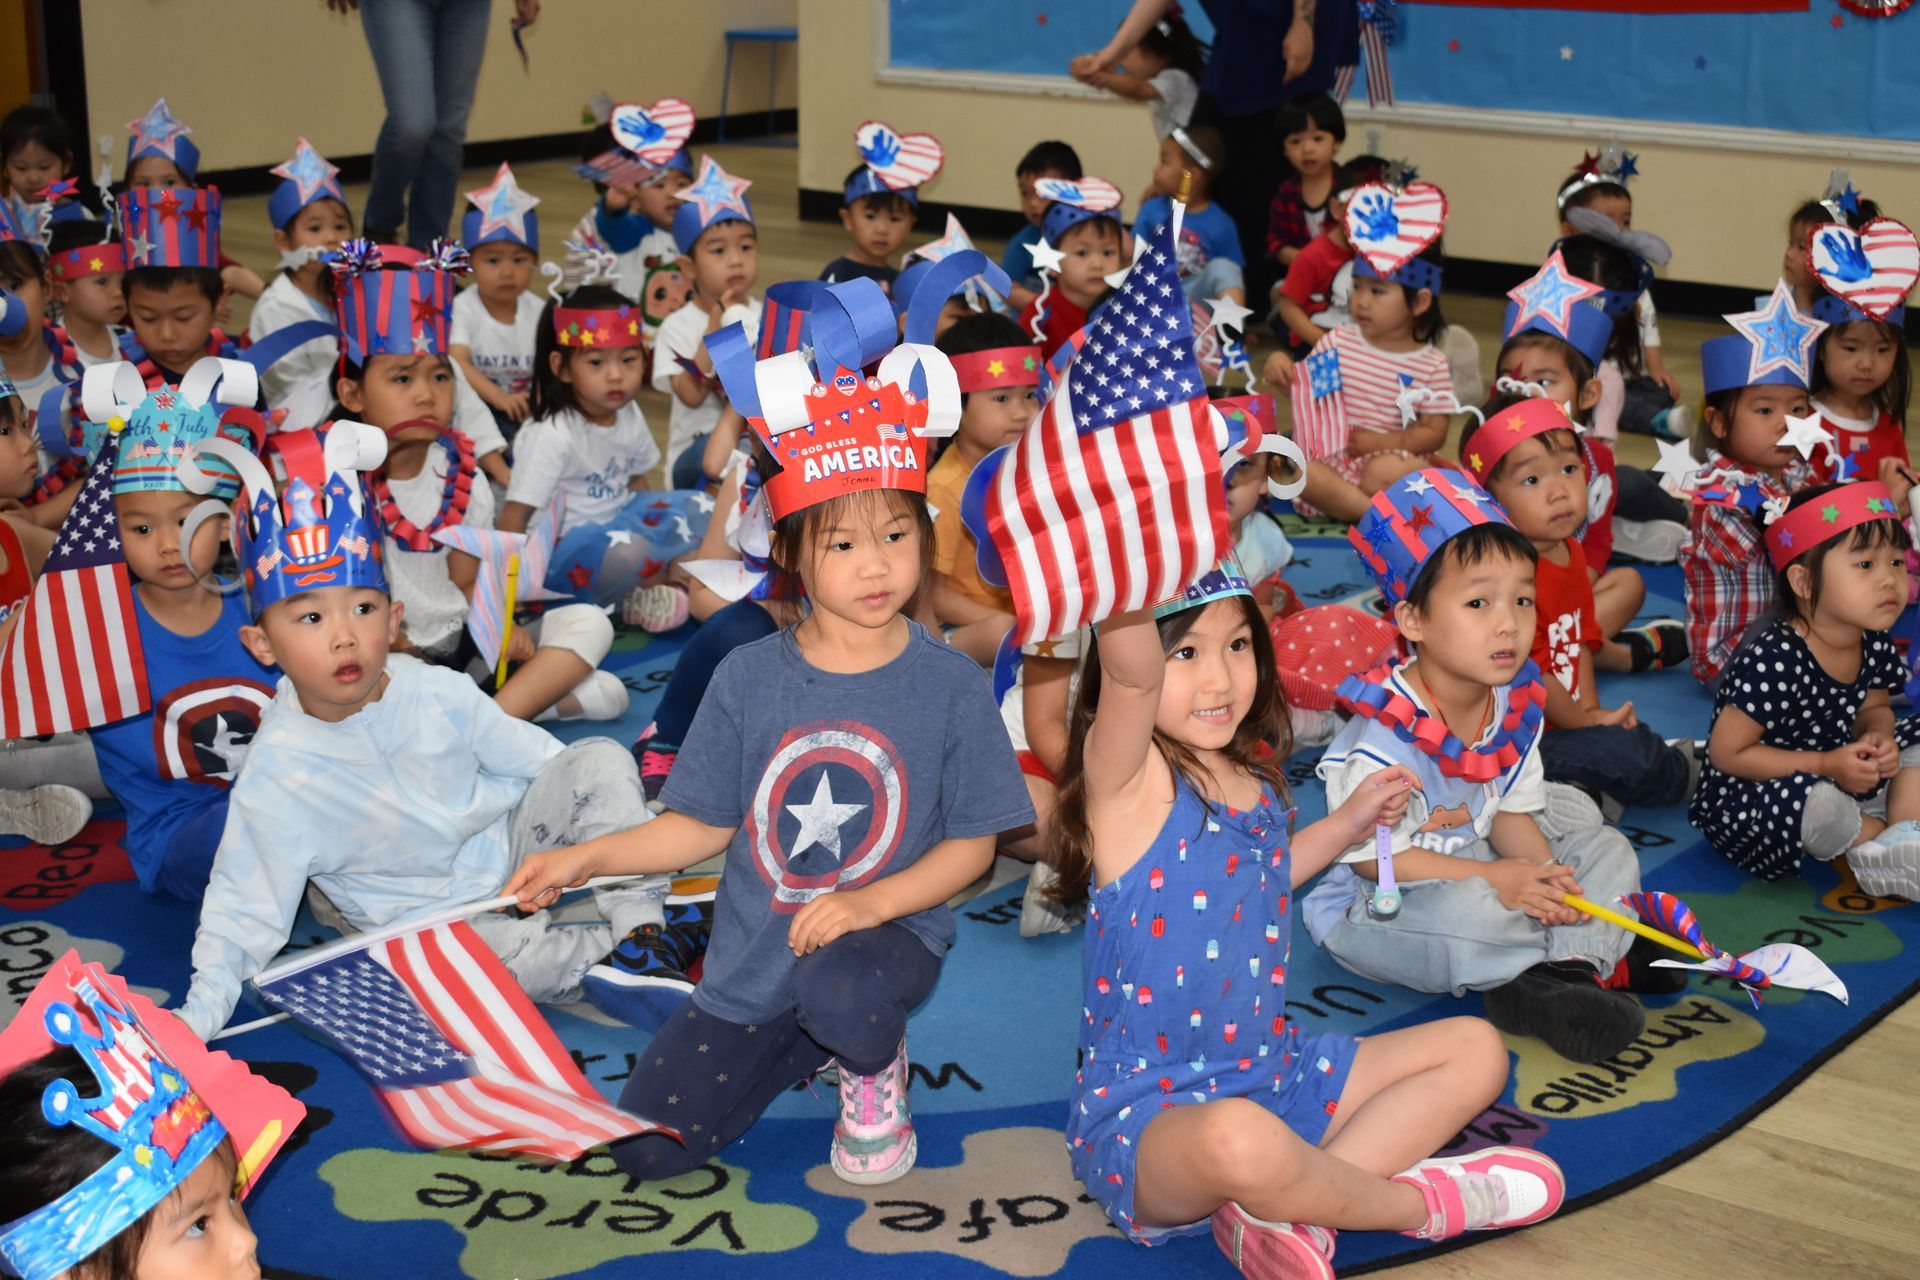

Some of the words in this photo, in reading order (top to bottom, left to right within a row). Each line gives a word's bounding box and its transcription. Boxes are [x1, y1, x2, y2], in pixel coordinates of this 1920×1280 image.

[175, 413, 208, 437] July
[801, 444, 823, 456] GOD
[826, 437, 857, 449] BLESS
[804, 445, 918, 484] AMERICA
[3, 843, 103, 899] Red
[0, 926, 54, 1002] nco
[1531, 1001, 1731, 1114] Amarillo
[416, 1172, 746, 1250] Verde
[874, 1194, 1105, 1243] afe
